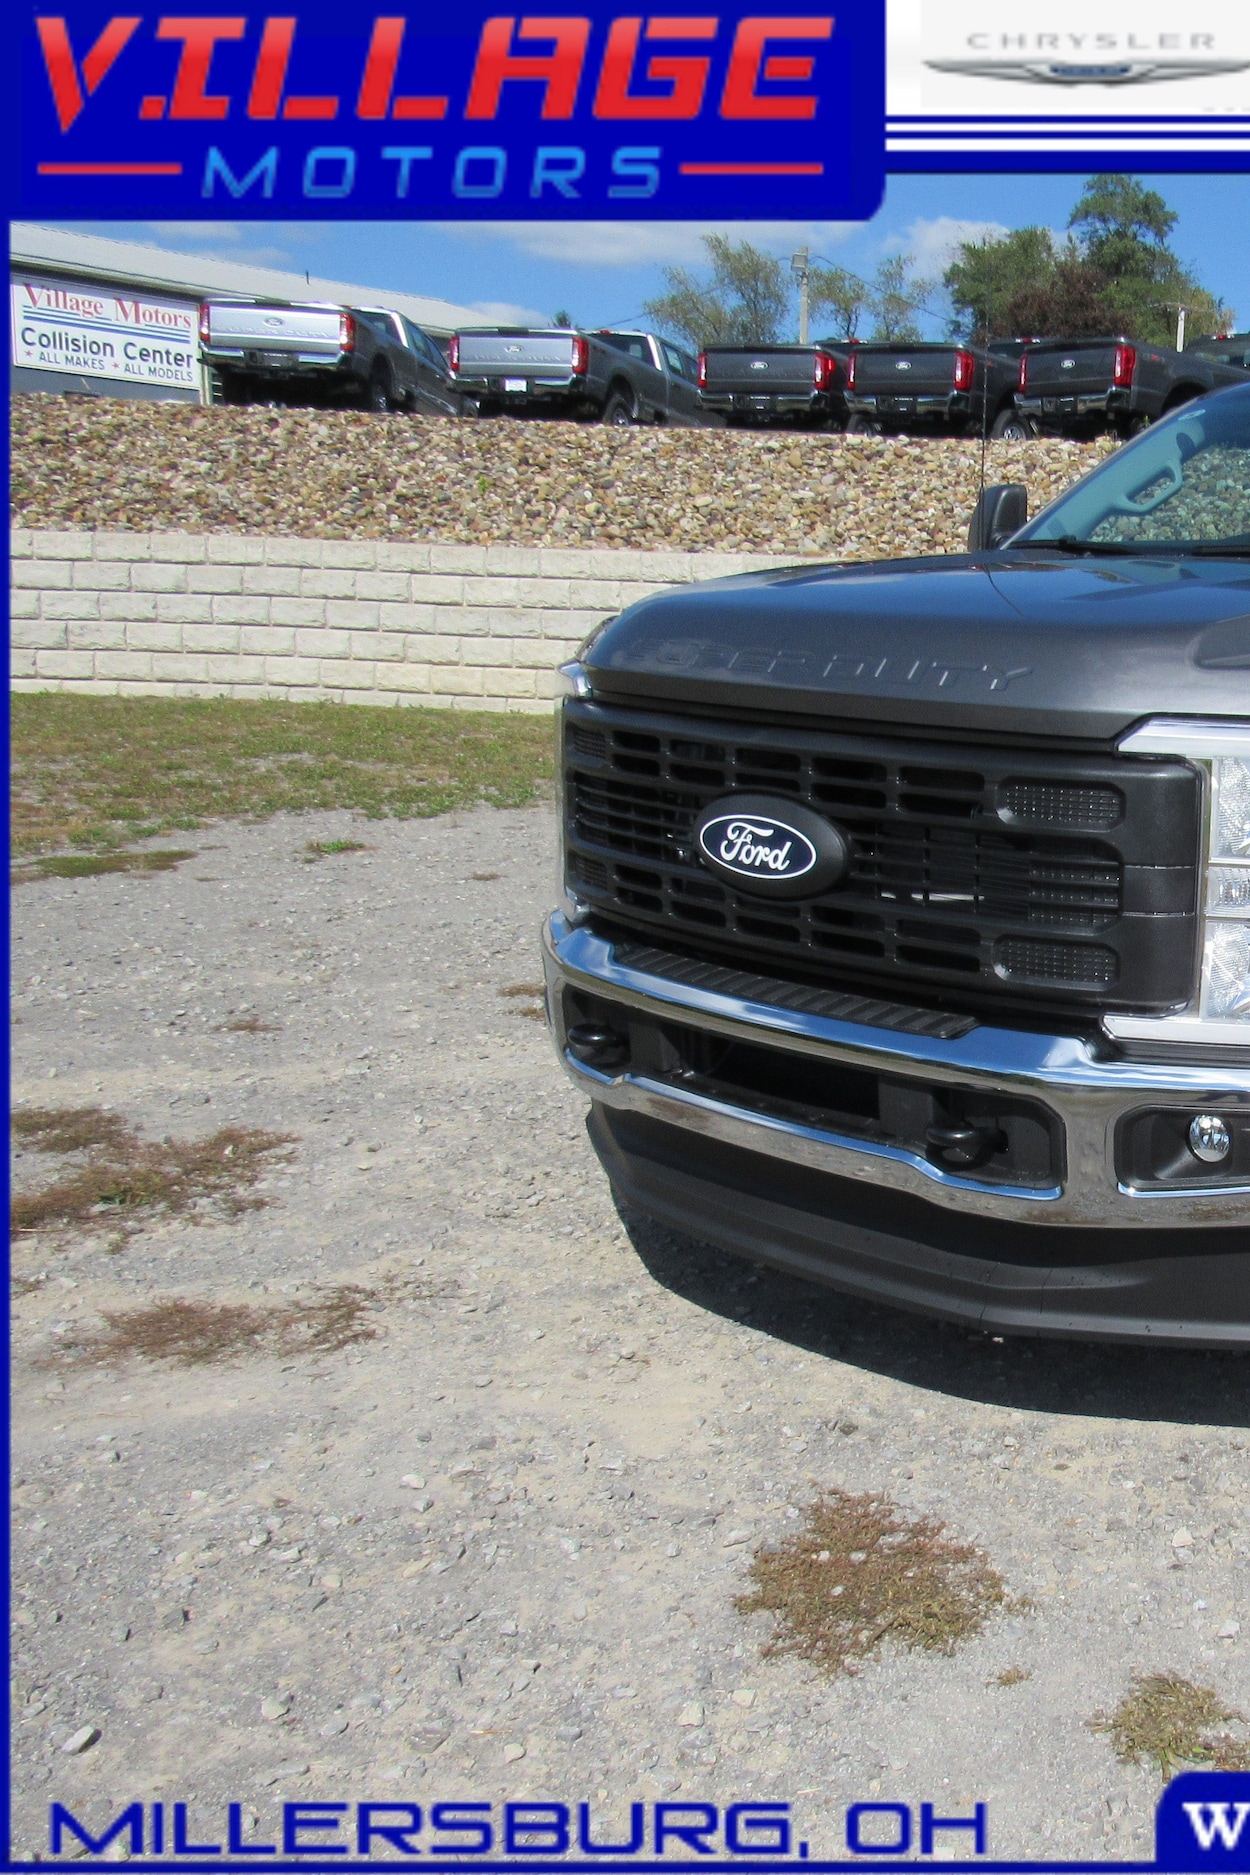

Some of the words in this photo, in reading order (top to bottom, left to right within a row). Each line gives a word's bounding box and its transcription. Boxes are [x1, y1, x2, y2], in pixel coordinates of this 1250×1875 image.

[22, 282, 105, 319] Village
[113, 297, 192, 329] Motors
[21, 327, 115, 358] Collision
[124, 342, 193, 369] Center
[39, 351, 61, 365] ALL
[65, 355, 106, 371] MAKES
[124, 363, 145, 376] ALL
[148, 366, 193, 382] MODELS
[820, 652, 1034, 692] DUTY
[720, 822, 794, 871] Ford
